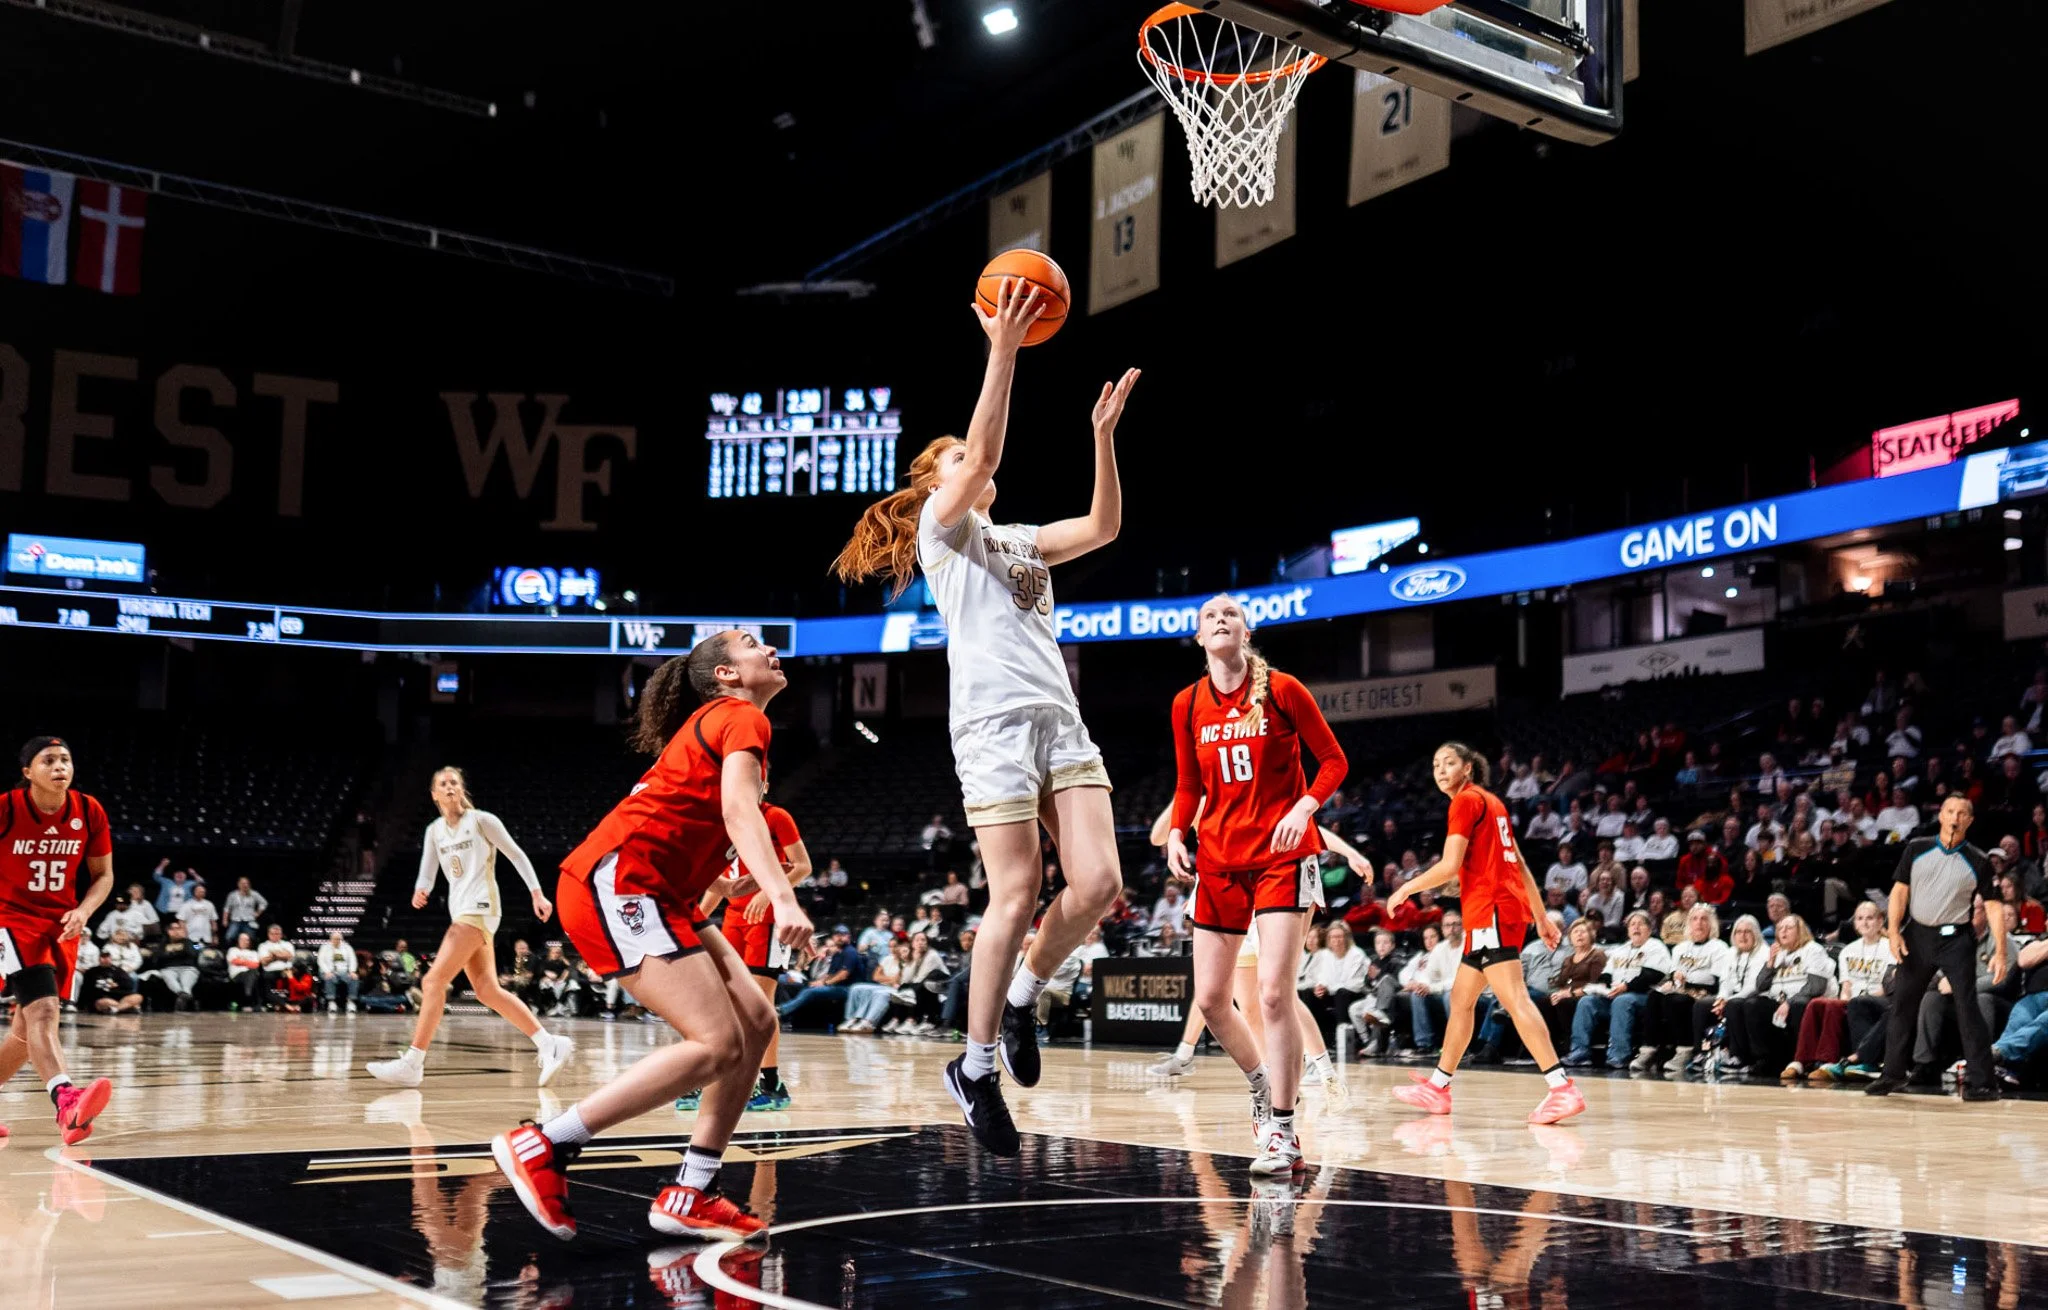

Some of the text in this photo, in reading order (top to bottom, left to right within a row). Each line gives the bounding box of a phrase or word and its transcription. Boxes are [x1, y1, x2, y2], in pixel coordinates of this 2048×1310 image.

[1381, 85, 1411, 135] 21
[1115, 215, 1136, 256] 13
[1620, 503, 1777, 568] GAME ON
[1009, 563, 1048, 616] 35
[1404, 571, 1452, 597] Ford
[1056, 605, 1122, 638] Ford
[1314, 683, 1423, 716] AKE FOREST
[1201, 724, 1221, 744] NC
[1218, 744, 1253, 783] 18
[12, 839, 82, 855] NC STATE
[28, 860, 67, 892] 35
[1103, 974, 1188, 1000] WAKE FOREST
[1106, 1002, 1183, 1022] BASKETBALL
